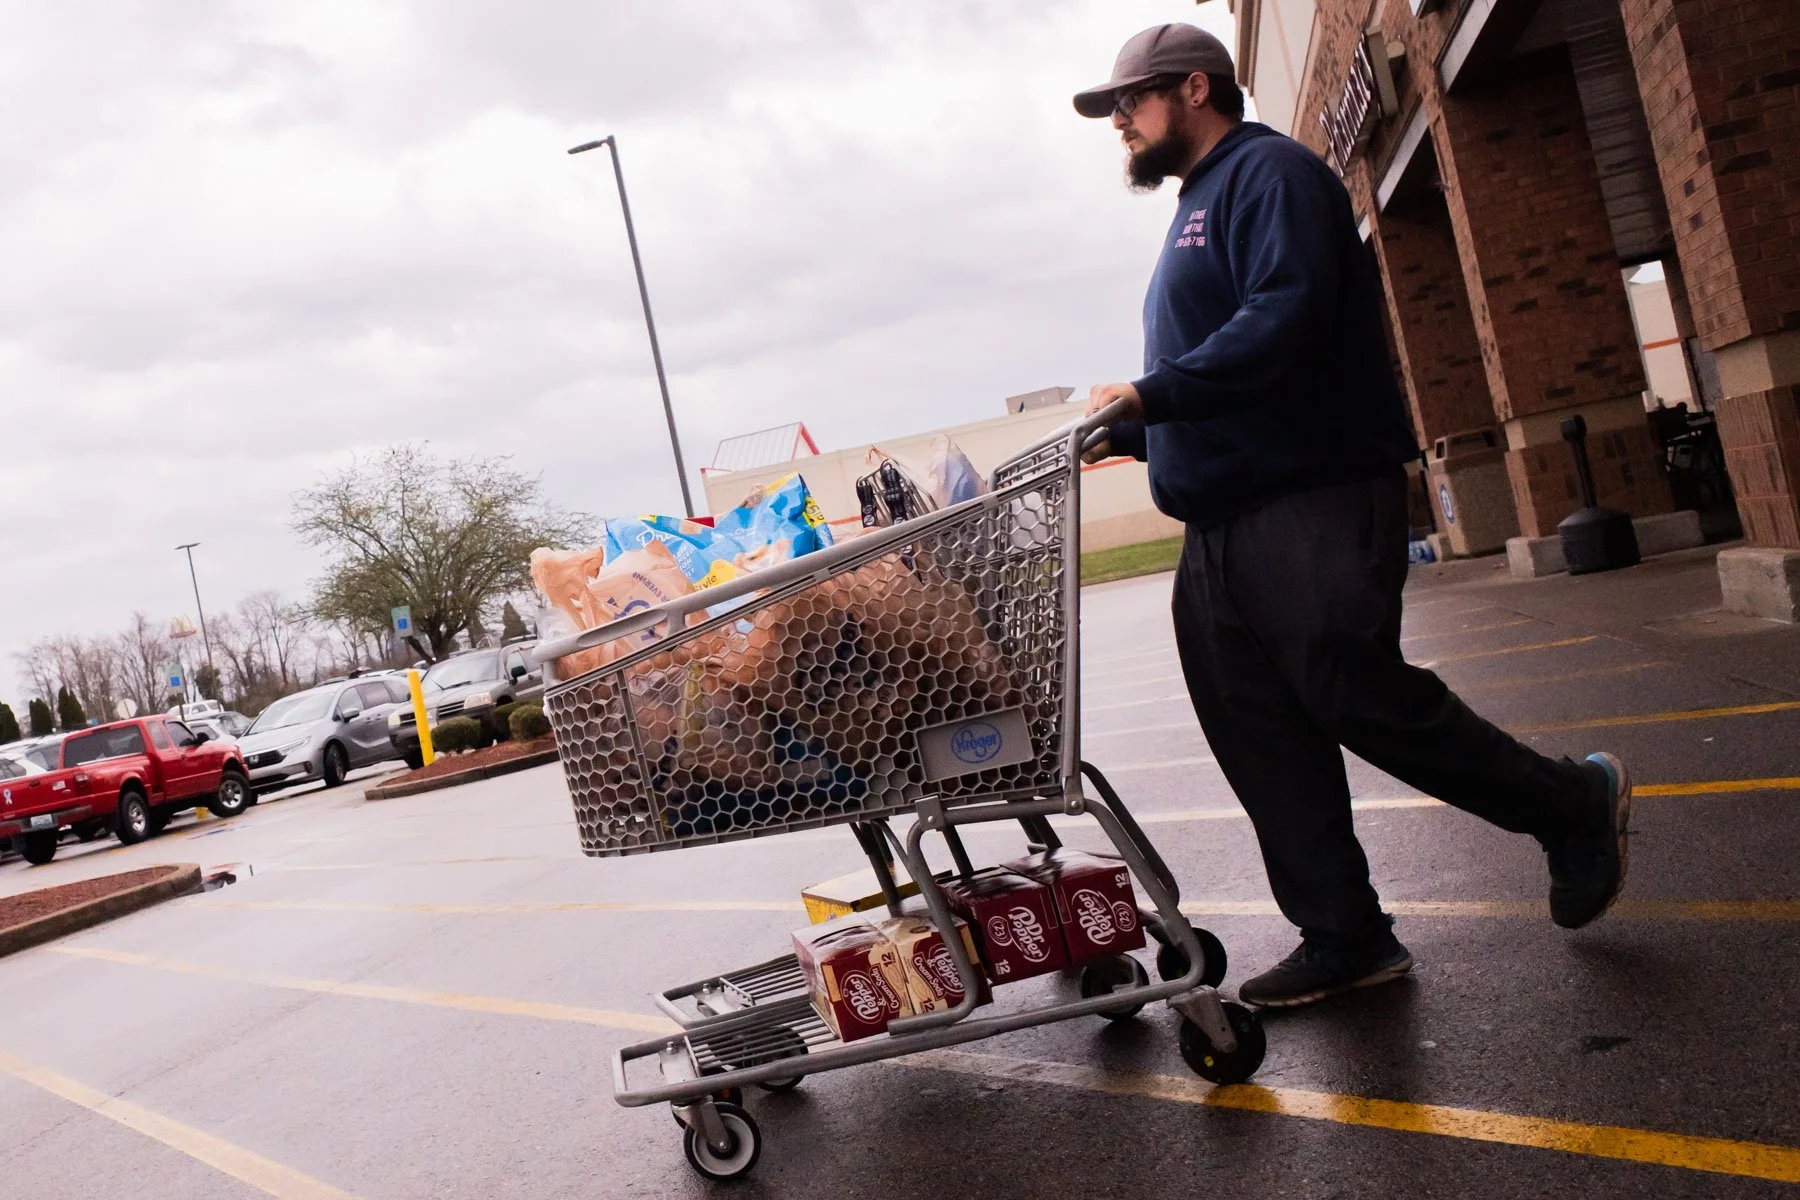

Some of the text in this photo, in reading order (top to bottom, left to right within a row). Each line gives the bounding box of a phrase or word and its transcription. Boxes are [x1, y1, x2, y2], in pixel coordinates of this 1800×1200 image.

[955, 729, 997, 758] Kroger
[1115, 872, 1127, 888] 12
[1077, 908, 1097, 930] Dr
[1079, 893, 1116, 945] Pepper
[1118, 911, 1130, 924] 23
[993, 924, 1006, 937] 23
[1008, 906, 1043, 958] Pepper
[1027, 922, 1045, 943] Dr
[881, 951, 893, 967] 12
[927, 958, 936, 967] &
[998, 959, 1011, 975] 12
[913, 956, 945, 996] Cream Soda
[849, 988, 863, 1008] Dr
[850, 967, 880, 1020] Pepper
[871, 967, 900, 1009] Cream Soda
[877, 997, 887, 1006] &
[922, 997, 935, 1013] 12
